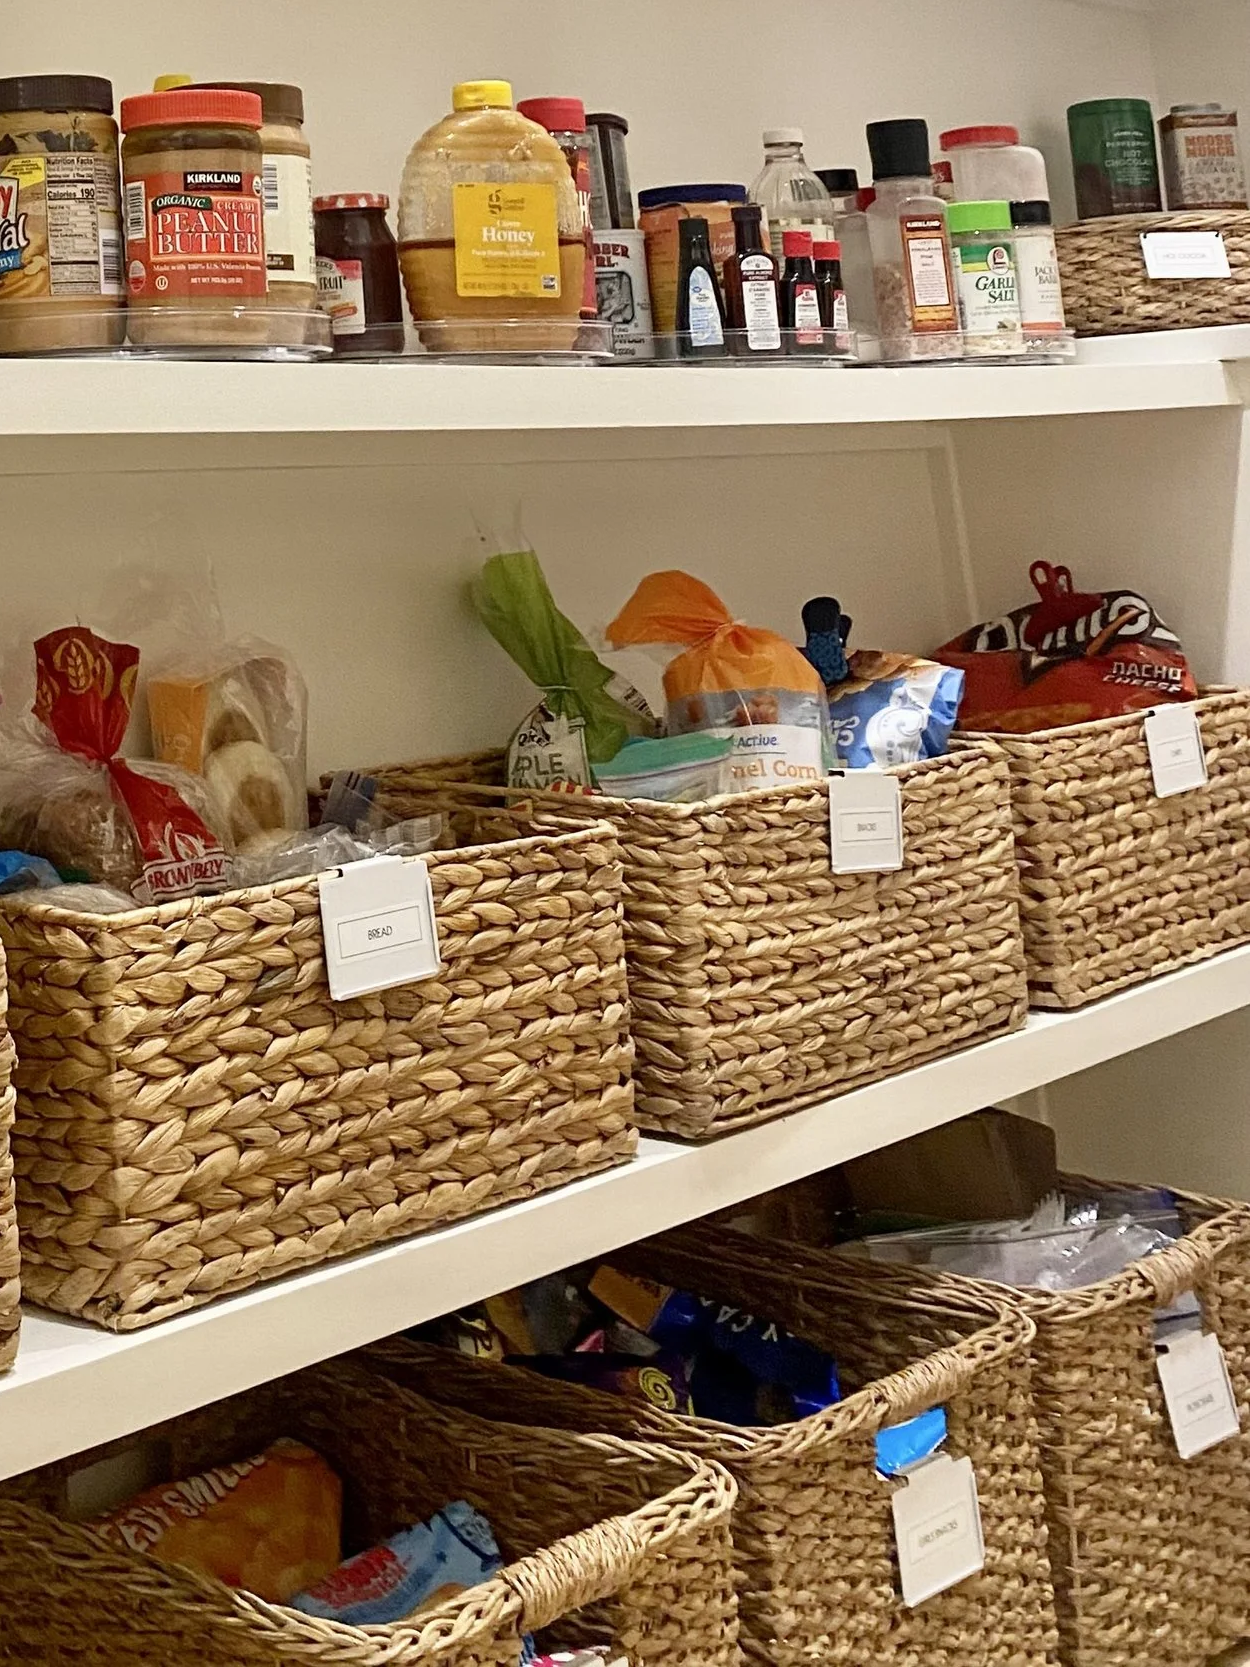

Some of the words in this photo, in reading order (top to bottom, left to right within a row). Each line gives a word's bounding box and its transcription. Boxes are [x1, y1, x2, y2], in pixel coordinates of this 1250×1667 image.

[46, 156, 75, 165] Nutrition
[76, 157, 93, 165] Facts
[1123, 150, 1141, 158] HOT
[186, 173, 241, 184] KIRKLAND
[80, 188, 95, 198] 190
[156, 194, 206, 208] ORGANIC
[216, 201, 255, 212] CREAMY
[156, 210, 259, 234] PEANUT
[157, 232, 260, 255] BUTTER
[482, 226, 535, 247] Honey
[153, 264, 170, 272] Made
[171, 263, 186, 271] with
[318, 276, 343, 291] FRUIT
[1111, 660, 1184, 682] NACHO
[772, 759, 819, 780] Corn
[367, 925, 393, 941] BREAD
